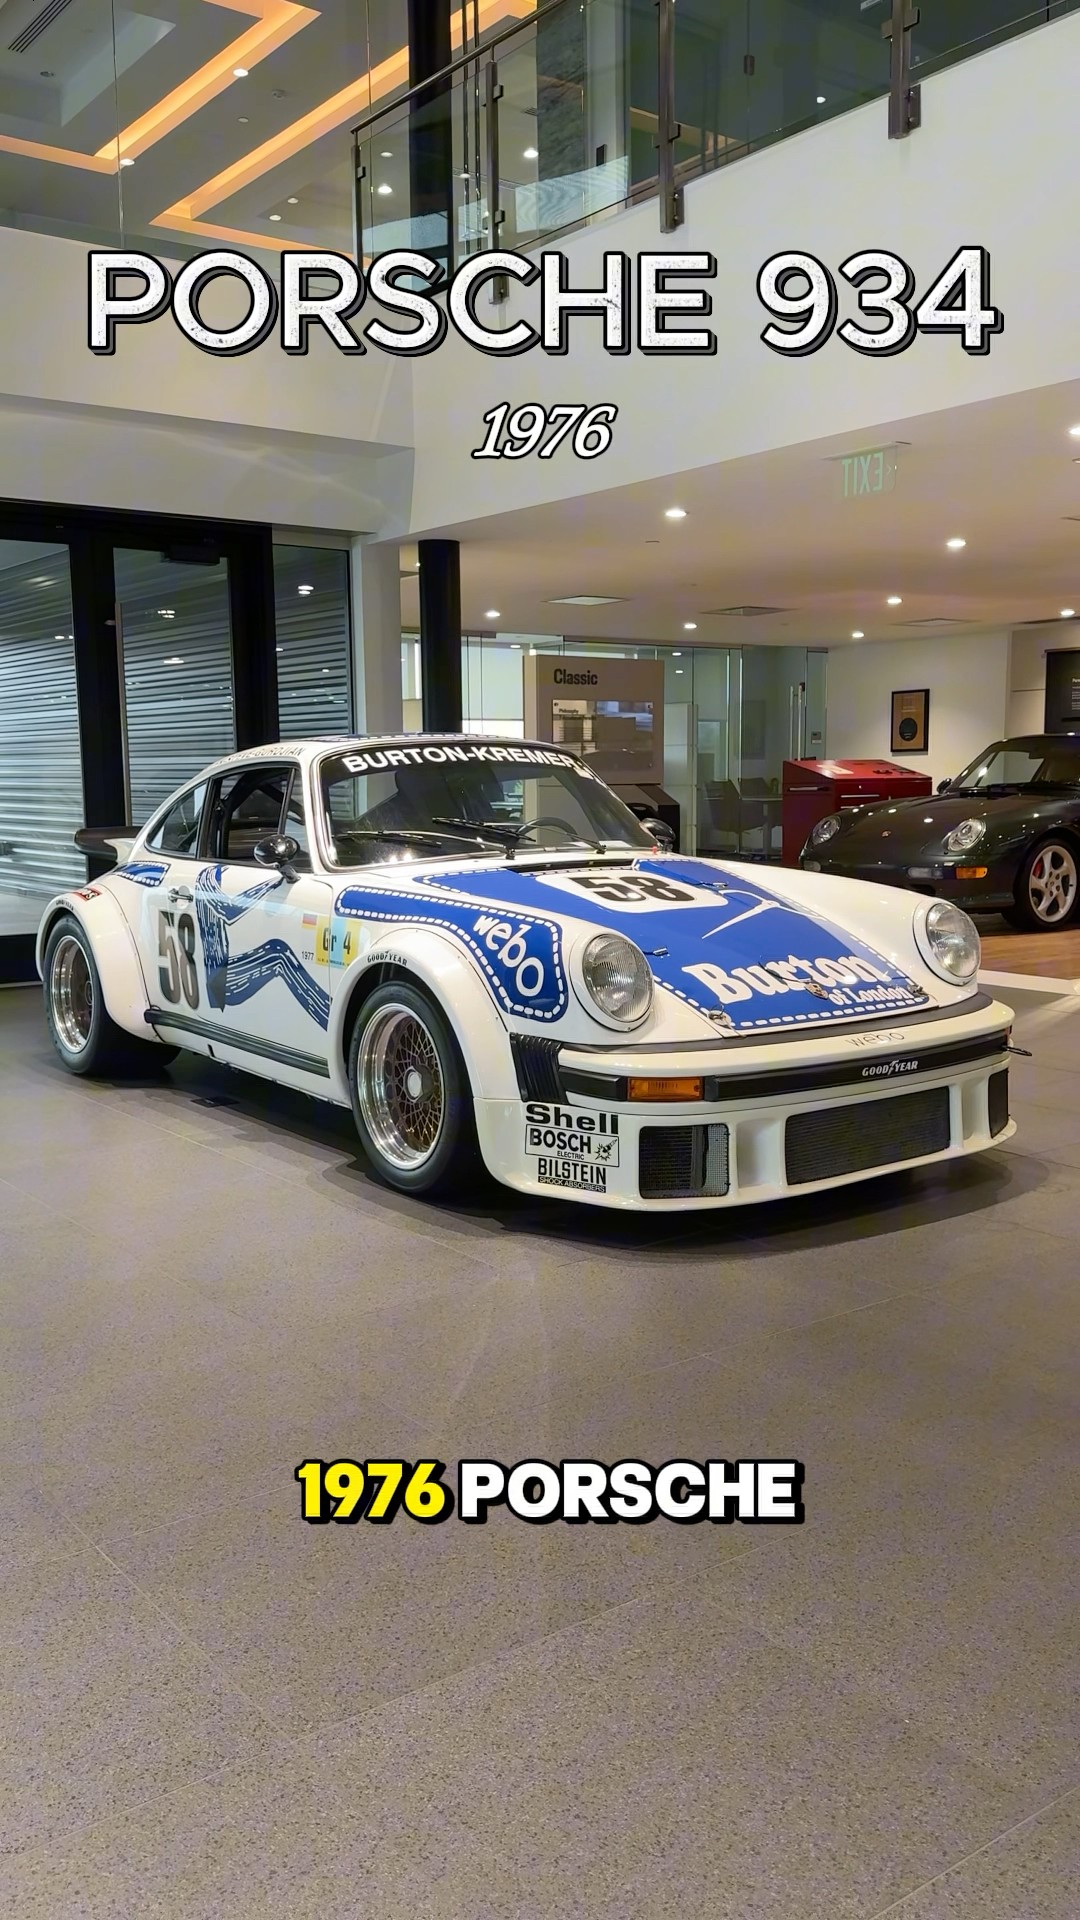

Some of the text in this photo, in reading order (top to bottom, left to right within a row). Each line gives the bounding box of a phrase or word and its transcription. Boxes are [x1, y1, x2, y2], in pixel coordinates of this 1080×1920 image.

[553, 668, 598, 686] Classic
[341, 747, 574, 773] BURTON-KREMER
[568, 875, 697, 902] 58
[322, 927, 351, 955] Gr 4
[158, 910, 200, 1010] 58
[301, 950, 314, 961] 1977
[367, 952, 408, 967] GOODYEAR
[473, 914, 545, 997] webo
[681, 953, 892, 1004] Burton
[827, 984, 914, 1007] of London
[846, 1032, 904, 1047] webo
[862, 1059, 918, 1077] GOODYEAR
[525, 1104, 618, 1134] Shell
[529, 1128, 592, 1154] BOSCH
[557, 1150, 584, 1160] ELECTRIC
[537, 1158, 606, 1185] BILSTEIN
[539, 1177, 606, 1193] SHOCK ABSORBERS
